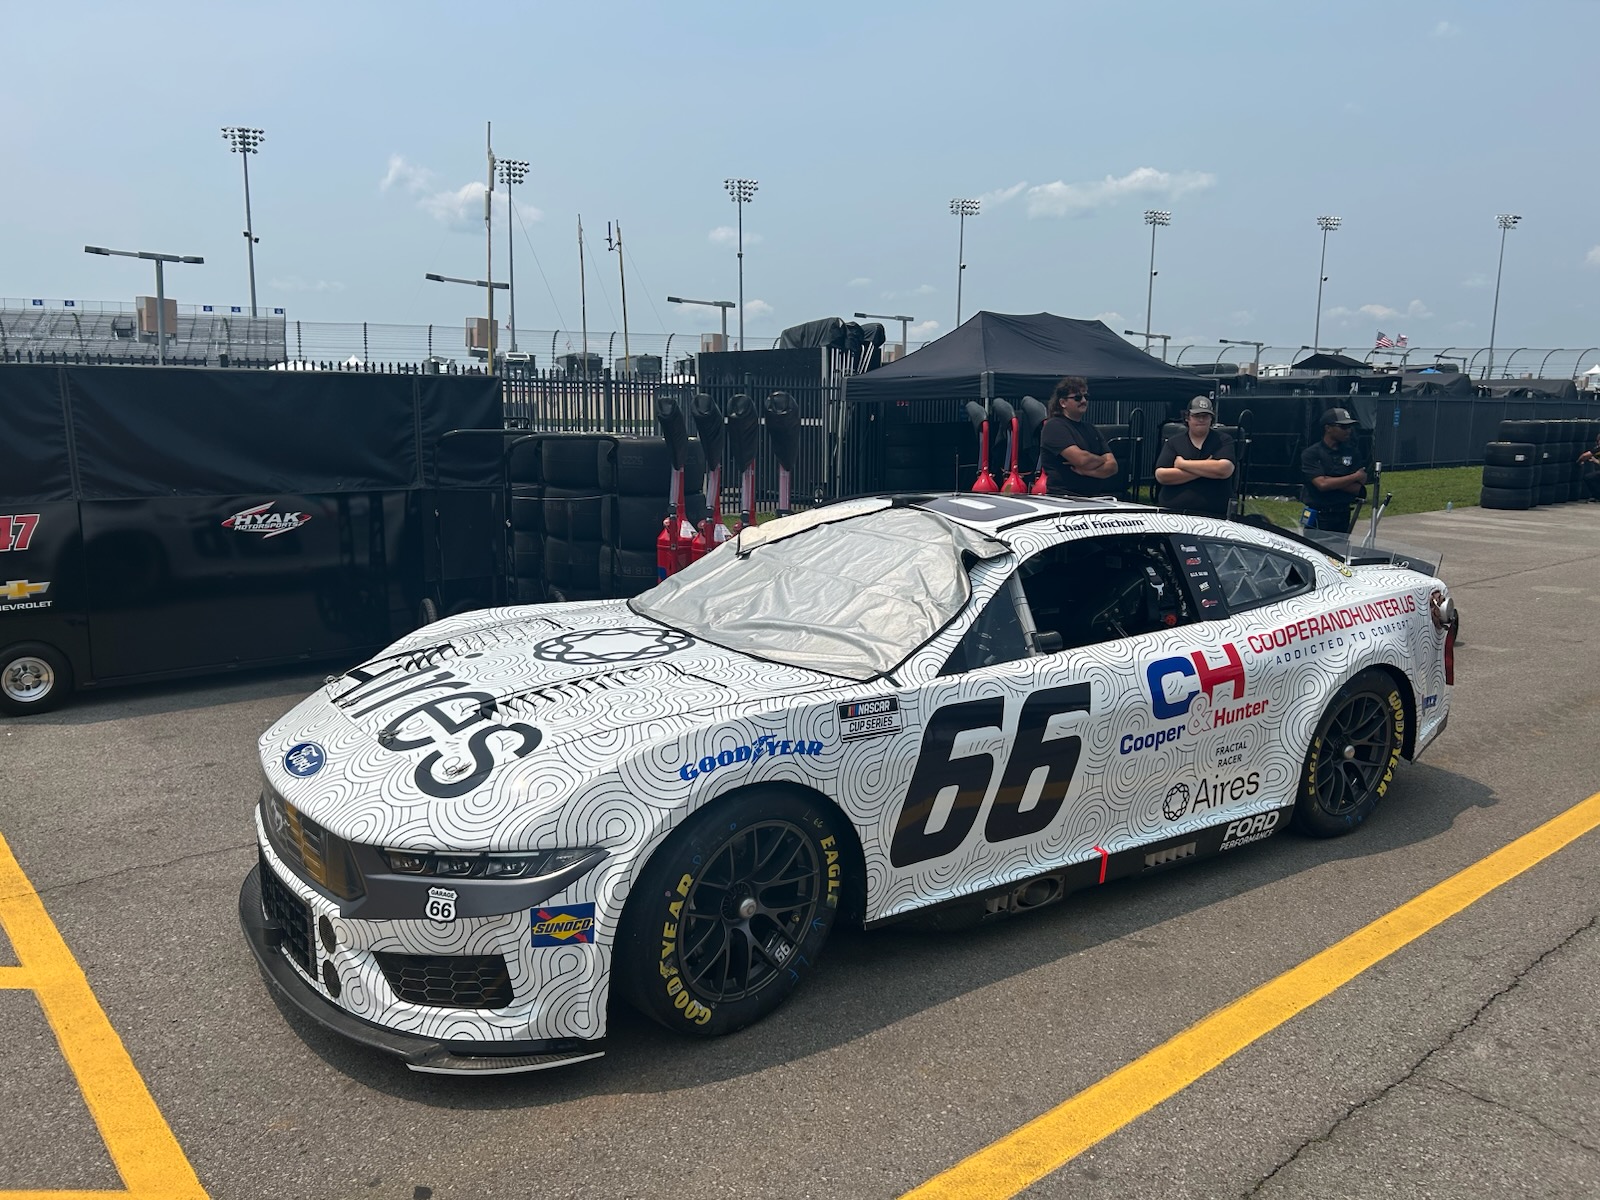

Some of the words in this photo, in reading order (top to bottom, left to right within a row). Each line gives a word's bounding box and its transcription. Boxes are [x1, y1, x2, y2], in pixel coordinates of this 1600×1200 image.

[1389, 381, 1398, 394] 5
[234, 512, 302, 526] HYAK
[234, 521, 299, 531] MOTORSPORTS
[1055, 521, 1089, 533] Chad
[1091, 519, 1144, 529] Finchum
[0, 601, 52, 611] EVROLET
[1247, 594, 1416, 655] COOPERANDHUNTER.US
[1276, 637, 1344, 665] ADDICTED
[1351, 631, 1366, 642] TO
[1371, 619, 1410, 637] COMFORT
[858, 700, 891, 717] NASCAR
[849, 718, 866, 733] CUP
[865, 716, 893, 730] SERIES
[1120, 724, 1186, 755] Cooper
[1187, 692, 1212, 735] &
[1213, 699, 1269, 728] Hunter
[1215, 741, 1248, 756] FRACTAL
[1217, 754, 1243, 768] RACER
[890, 682, 1092, 869] 66
[1192, 772, 1260, 814] Aires
[1223, 811, 1280, 842] FORD
[1219, 829, 1275, 852] PERFORMANCE
[430, 889, 455, 899] GARAGE
[429, 902, 453, 919] 66
[535, 918, 592, 935] SUNOCO
